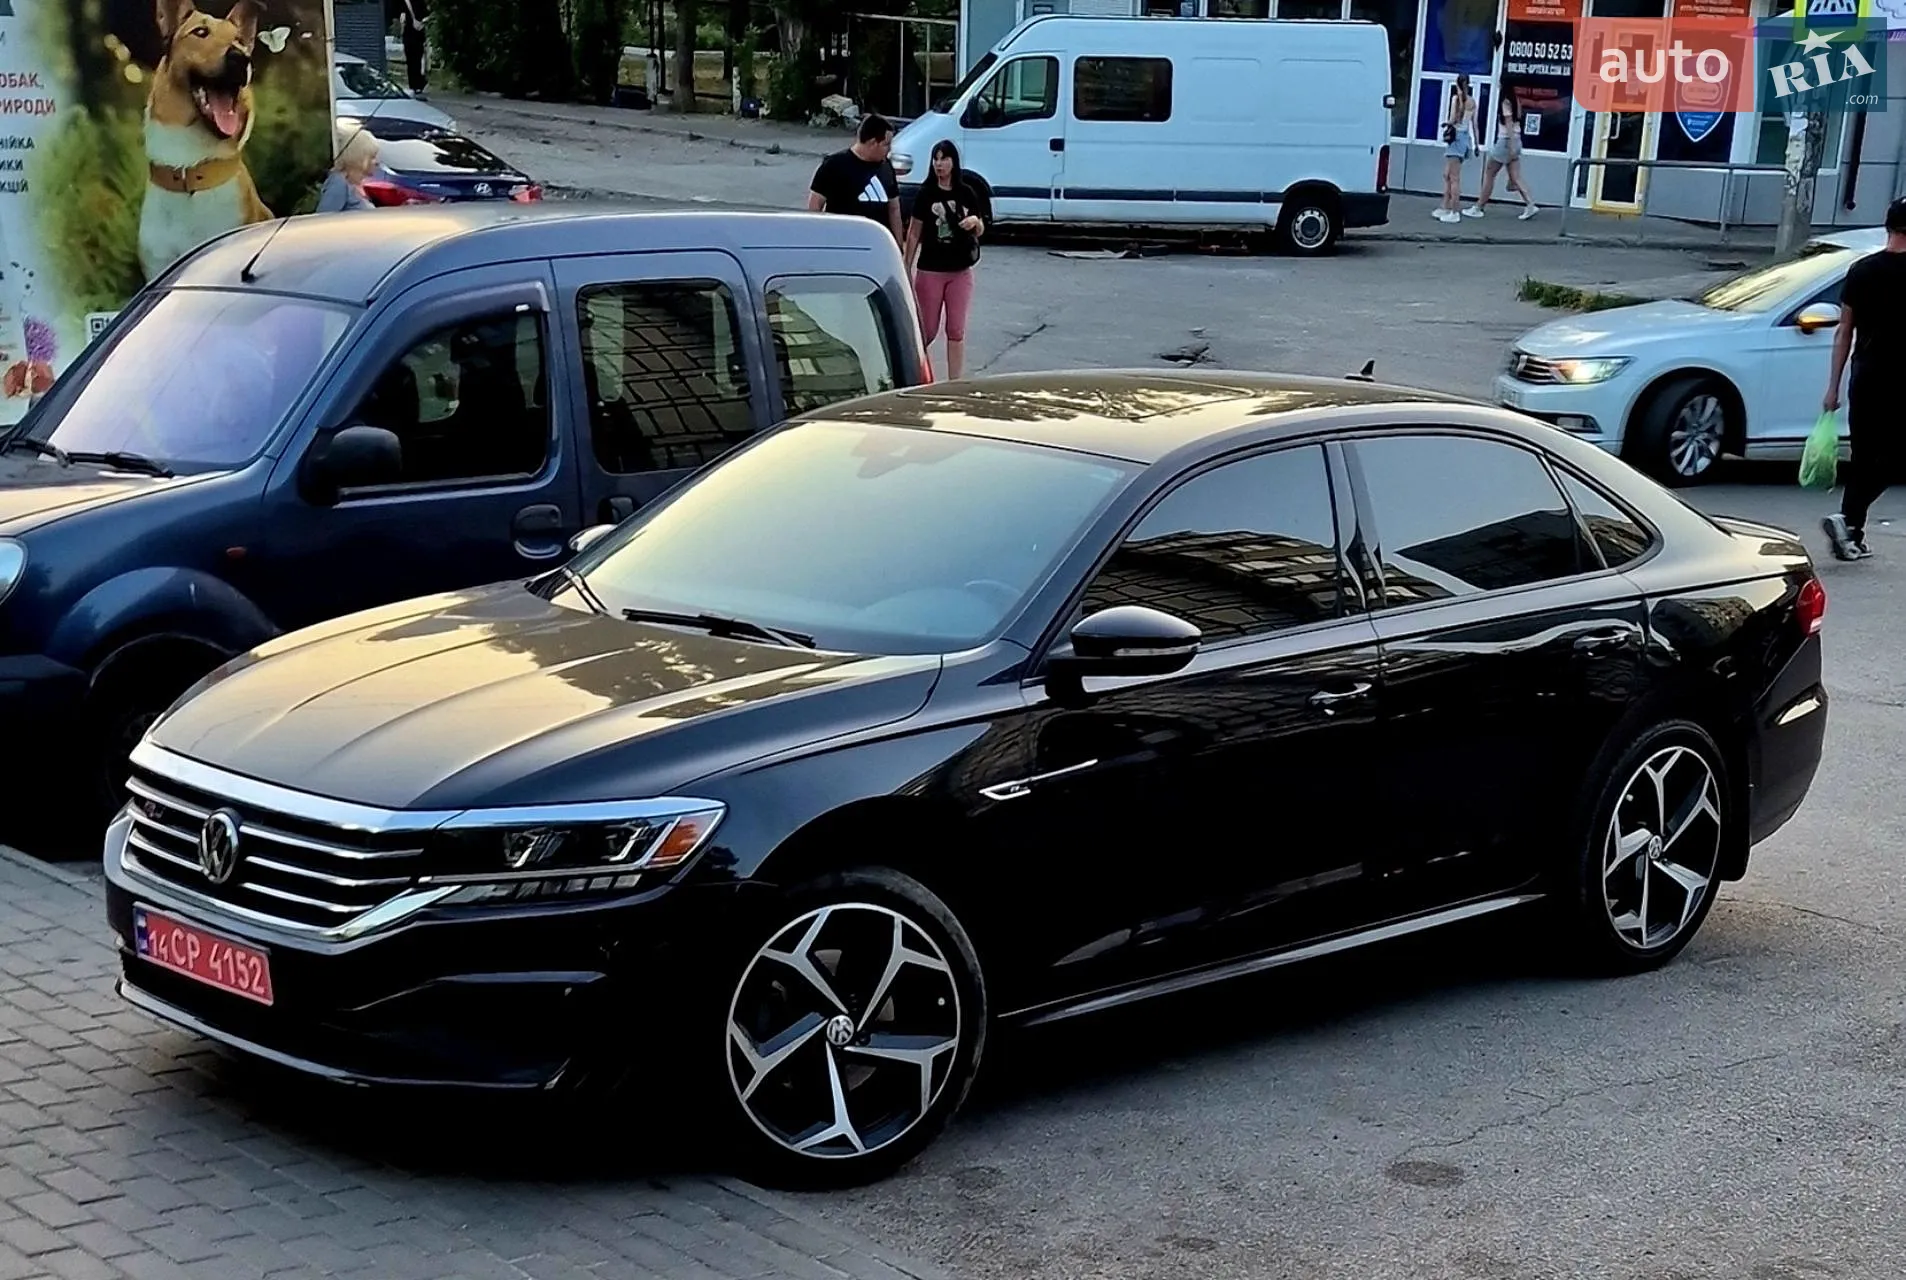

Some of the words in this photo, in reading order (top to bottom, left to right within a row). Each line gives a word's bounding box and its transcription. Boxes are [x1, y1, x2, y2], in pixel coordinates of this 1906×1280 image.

[1509, 41, 1533, 58] 0800
[1534, 42, 1547, 59] 50
[1547, 43, 1560, 59] 52
[1561, 44, 1573, 60] 53
[0, 98, 56, 116] ИРОДИ
[208, 942, 265, 994] 4152
